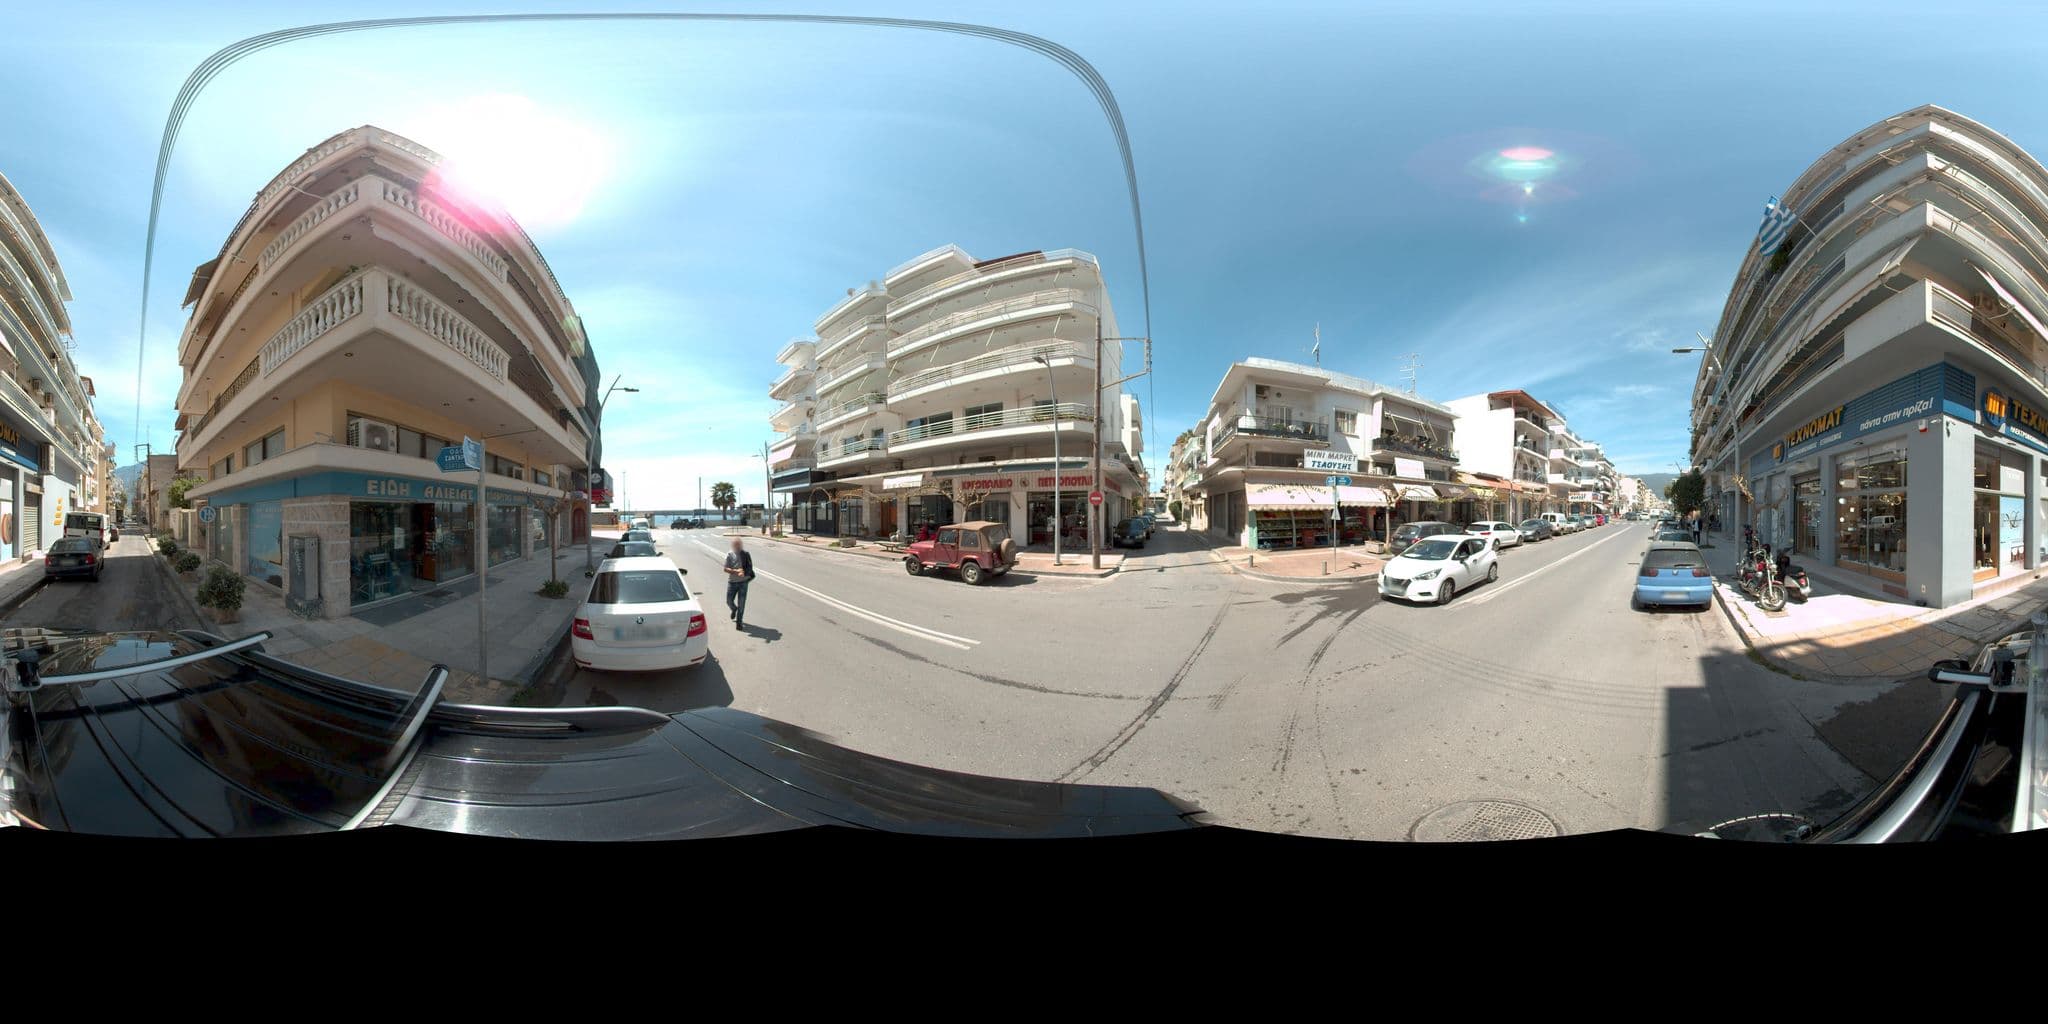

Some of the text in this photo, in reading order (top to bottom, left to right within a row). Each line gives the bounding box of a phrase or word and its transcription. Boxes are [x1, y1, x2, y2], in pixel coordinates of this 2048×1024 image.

[1882, 409, 1902, 423] στην
[1902, 397, 1934, 417] πρίζα!
[1784, 404, 1844, 448] ΤΕΧΝΟΜΑΤ
[1312, 460, 1352, 470] ΤΣΑΟΥΣΗΣ
[1328, 452, 1356, 462] ΜΑΡΚΕΤ
[367, 480, 409, 496] ΕΙΔΗ
[424, 486, 474, 499] ΑΛΙΕΙΑΣ
